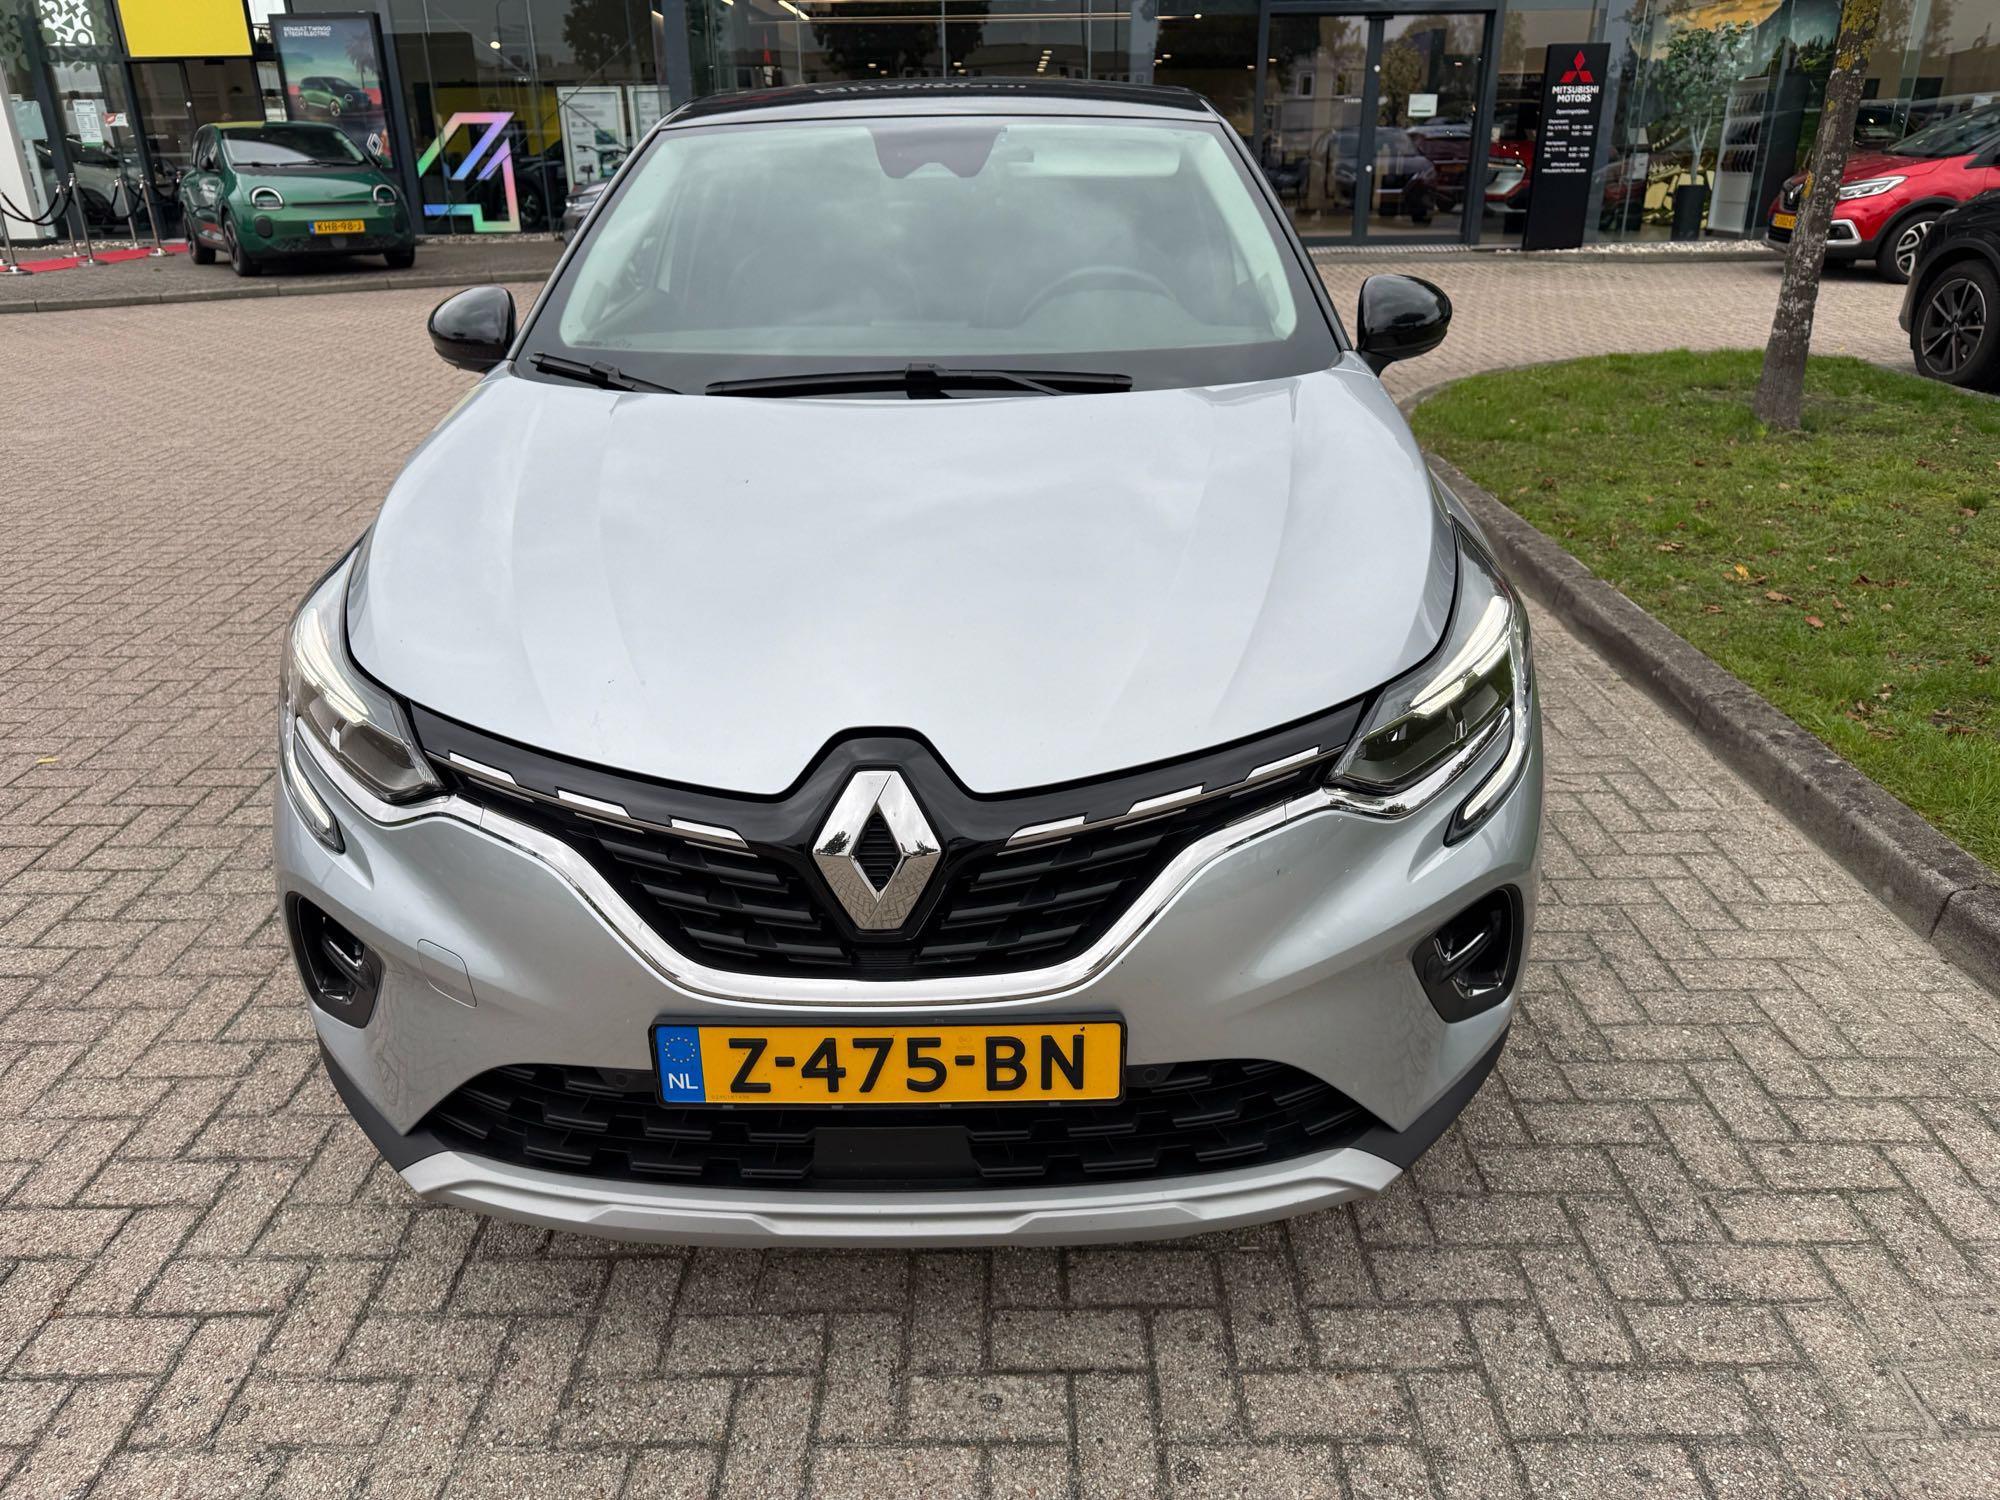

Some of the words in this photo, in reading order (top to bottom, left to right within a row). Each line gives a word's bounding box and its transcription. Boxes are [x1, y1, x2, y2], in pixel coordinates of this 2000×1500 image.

[1552, 86, 1599, 94] MITSUBISHI
[1557, 94, 1592, 102] MOTORS
[317, 221, 362, 232] KHB-98-J
[728, 1034, 1086, 1094] Z-475-BN
[669, 1072, 699, 1090] NL
